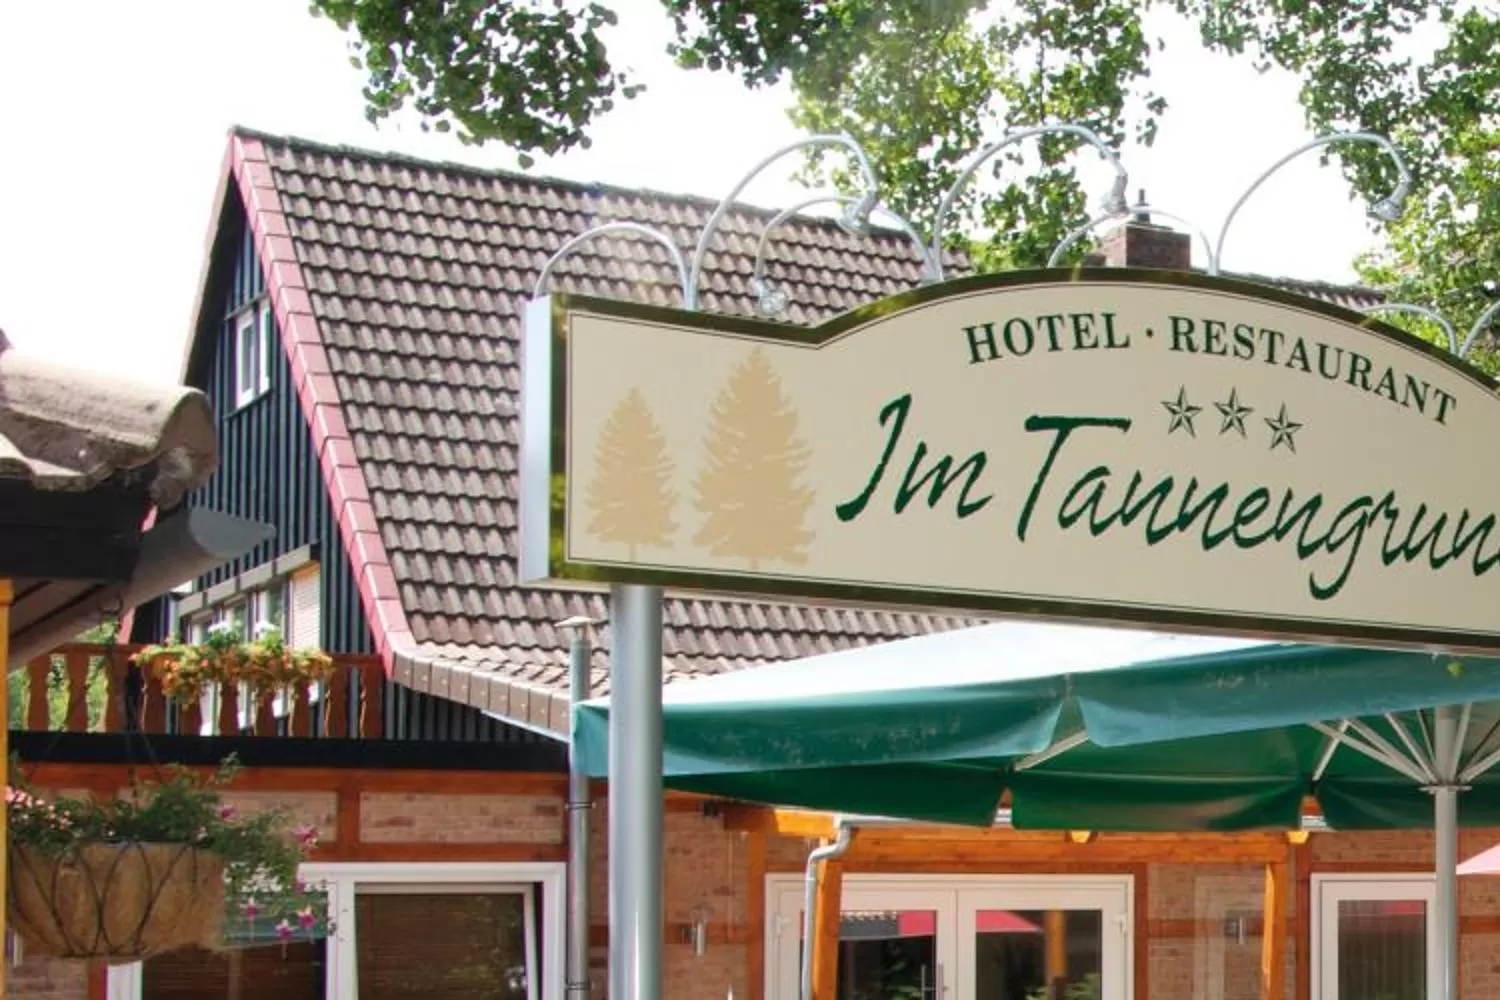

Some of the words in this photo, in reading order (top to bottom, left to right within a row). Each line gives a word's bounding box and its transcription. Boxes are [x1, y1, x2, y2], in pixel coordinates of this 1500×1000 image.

[962, 312, 1130, 365] HOTEL
[1169, 315, 1457, 425] RESTAURANT
[835, 393, 993, 522] Im
